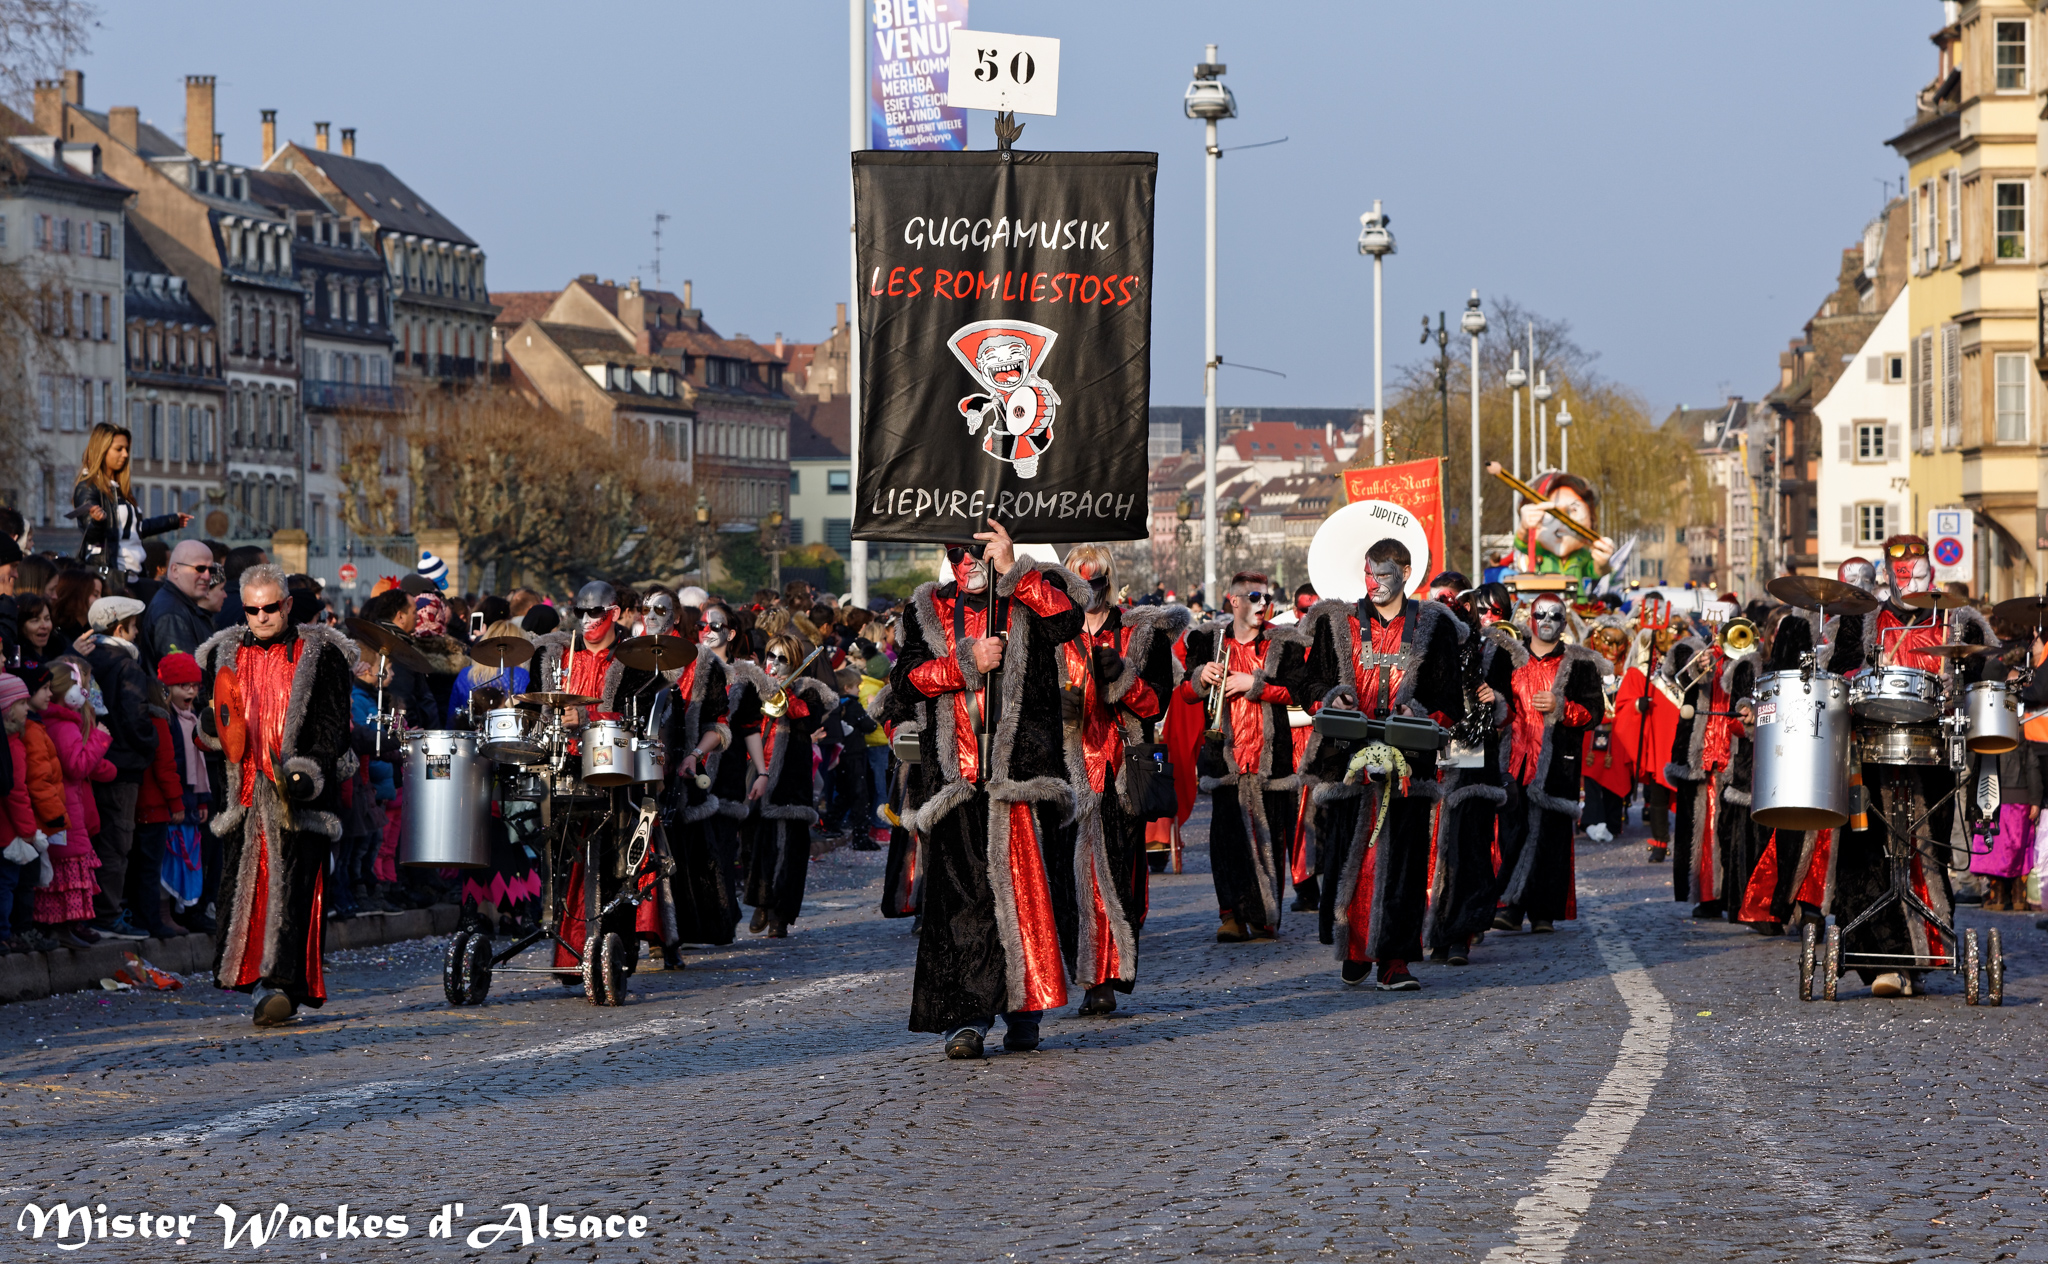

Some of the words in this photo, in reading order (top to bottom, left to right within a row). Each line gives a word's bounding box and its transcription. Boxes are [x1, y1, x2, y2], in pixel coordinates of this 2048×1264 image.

[875, 0, 948, 29] BIEN-
[974, 48, 1035, 84] 50
[882, 76, 935, 98] MERHBA
[884, 96, 910, 112] ESIET
[885, 106, 941, 126] BEM-VINDO
[916, 122, 936, 134] VENIT
[904, 216, 1111, 252] GUGGAMUSIK
[871, 266, 923, 298] LES
[933, 268, 1139, 307] ROMLIESTOSS'
[872, 488, 1135, 522] LIEPVRE-ROMBACH
[1369, 504, 1409, 528] JUPITER
[1758, 703, 1776, 715] ELSASS
[1760, 714, 1771, 725] FREI
